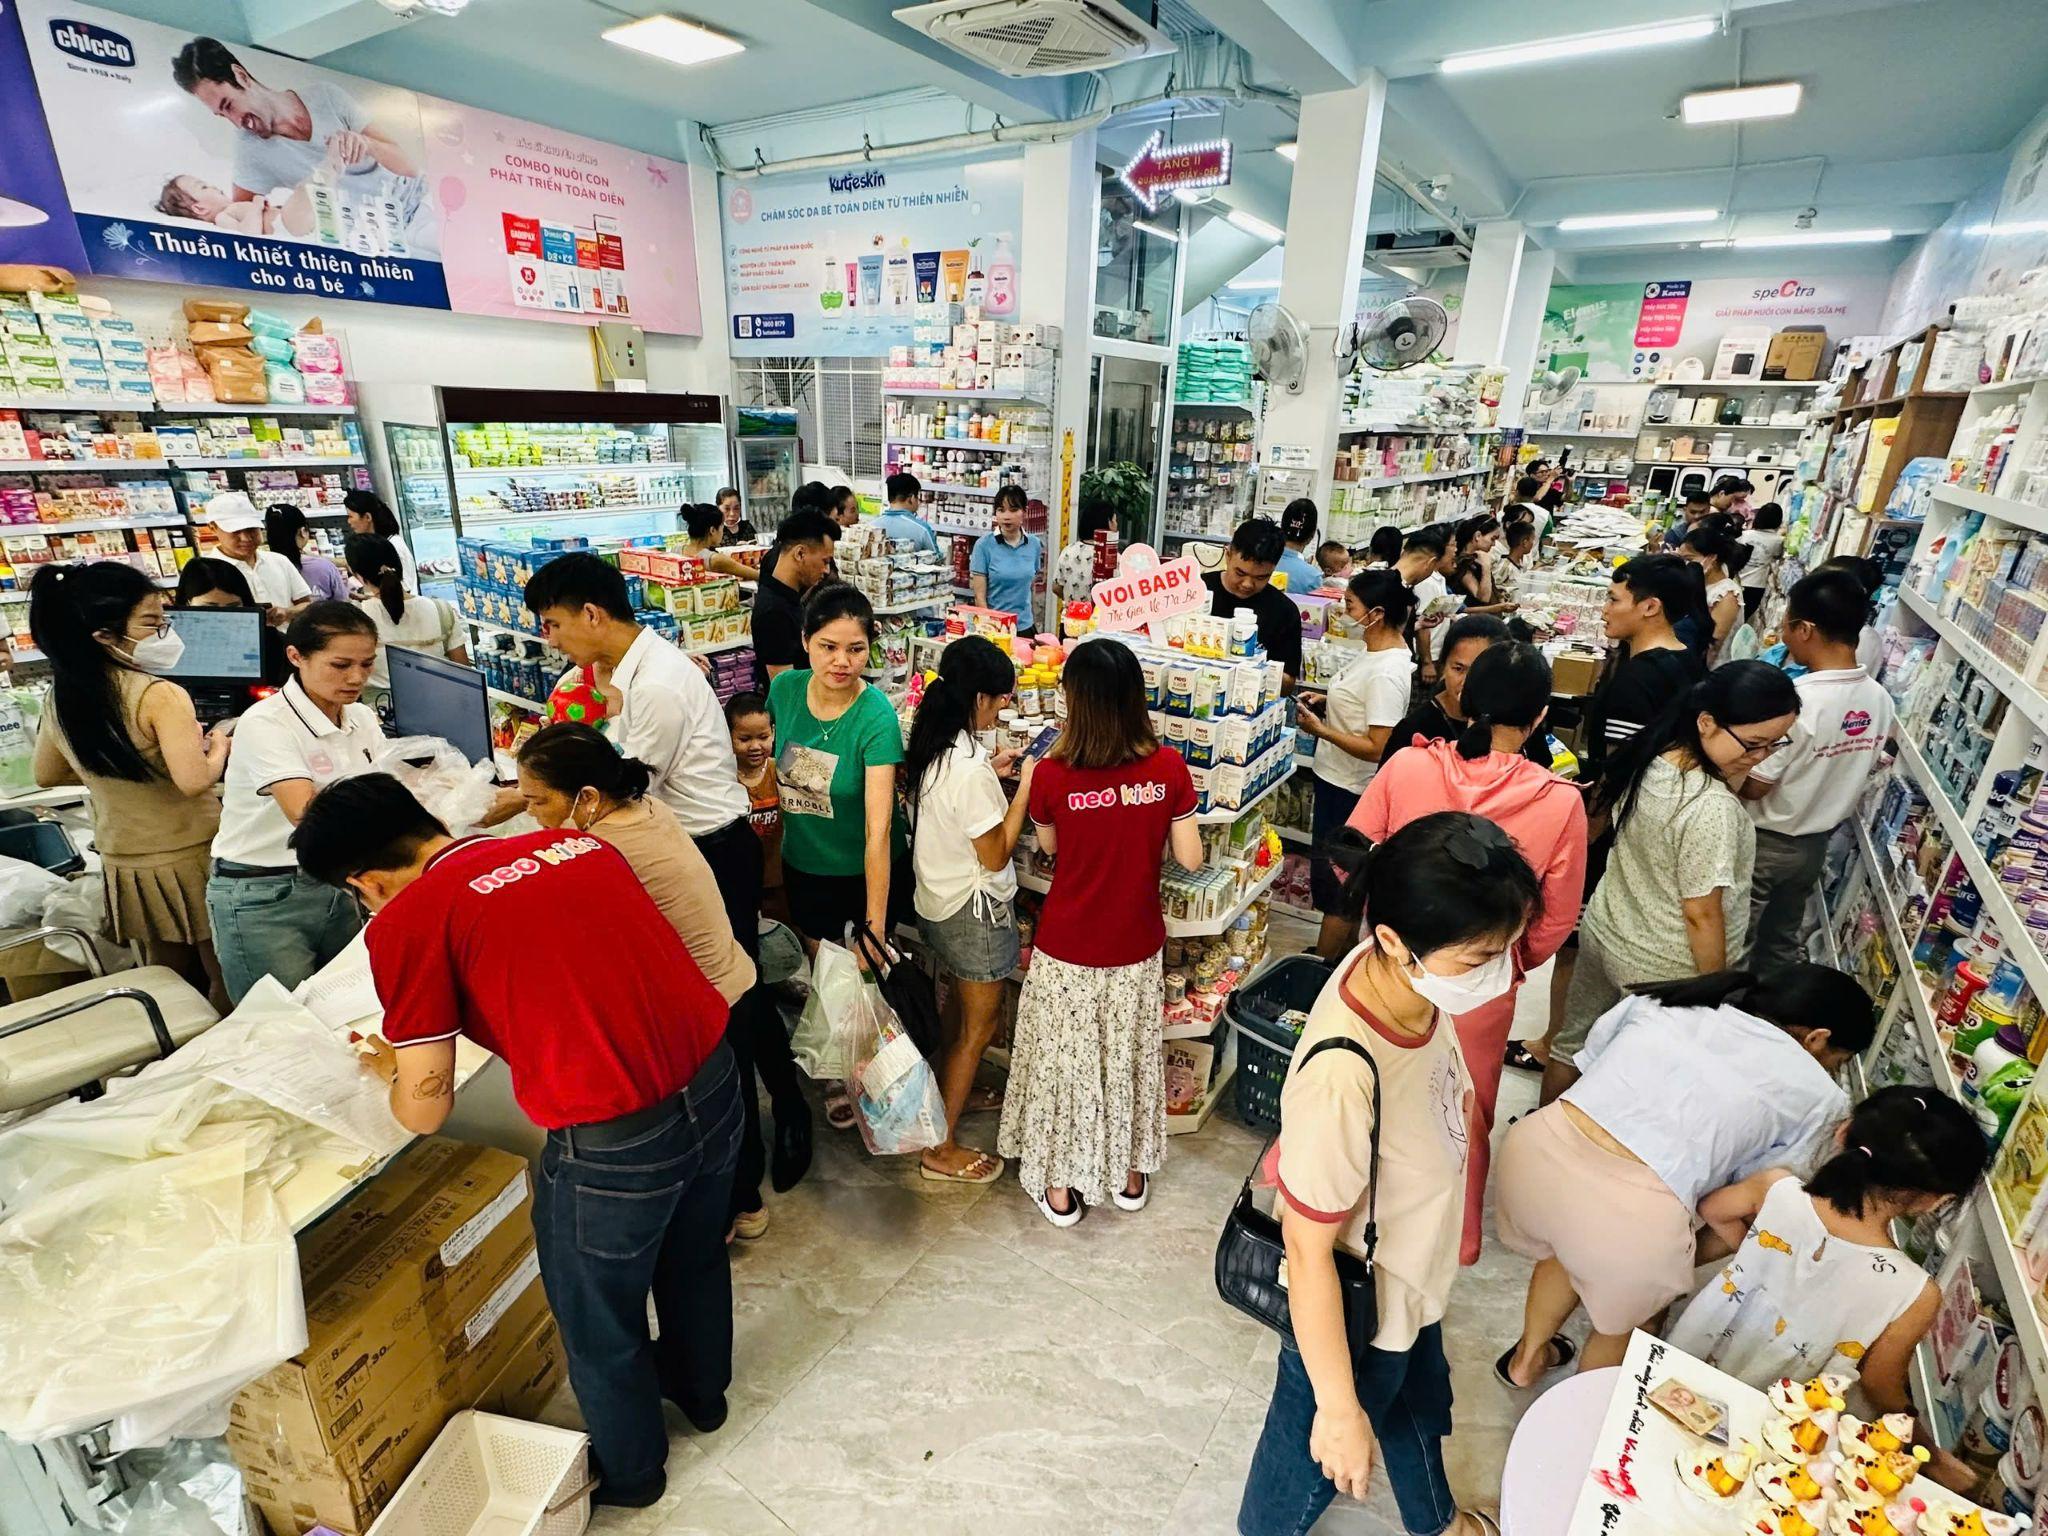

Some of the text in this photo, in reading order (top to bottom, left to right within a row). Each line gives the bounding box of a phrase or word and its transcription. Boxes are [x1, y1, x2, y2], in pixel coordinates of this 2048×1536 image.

[55, 24, 131, 62] chicco
[505, 154, 551, 174] COMBO
[586, 173, 609, 187] CON
[829, 171, 886, 194] kutieskin
[807, 206, 819, 217] DA
[149, 230, 415, 282] Thuần khiết thiên nhiên
[251, 268, 346, 294] cho da bé
[1661, 289, 1686, 297] Korea
[1775, 307, 1792, 316] CON
[1099, 565, 1191, 608] VOI BABY
[1173, 675, 1187, 683] neo
[1195, 726, 1208, 734] neo
[1840, 718, 1872, 731] Merries
[1068, 780, 1166, 811] neo kids
[468, 835, 603, 895] neo kids
[371, 1345, 388, 1365] 30
